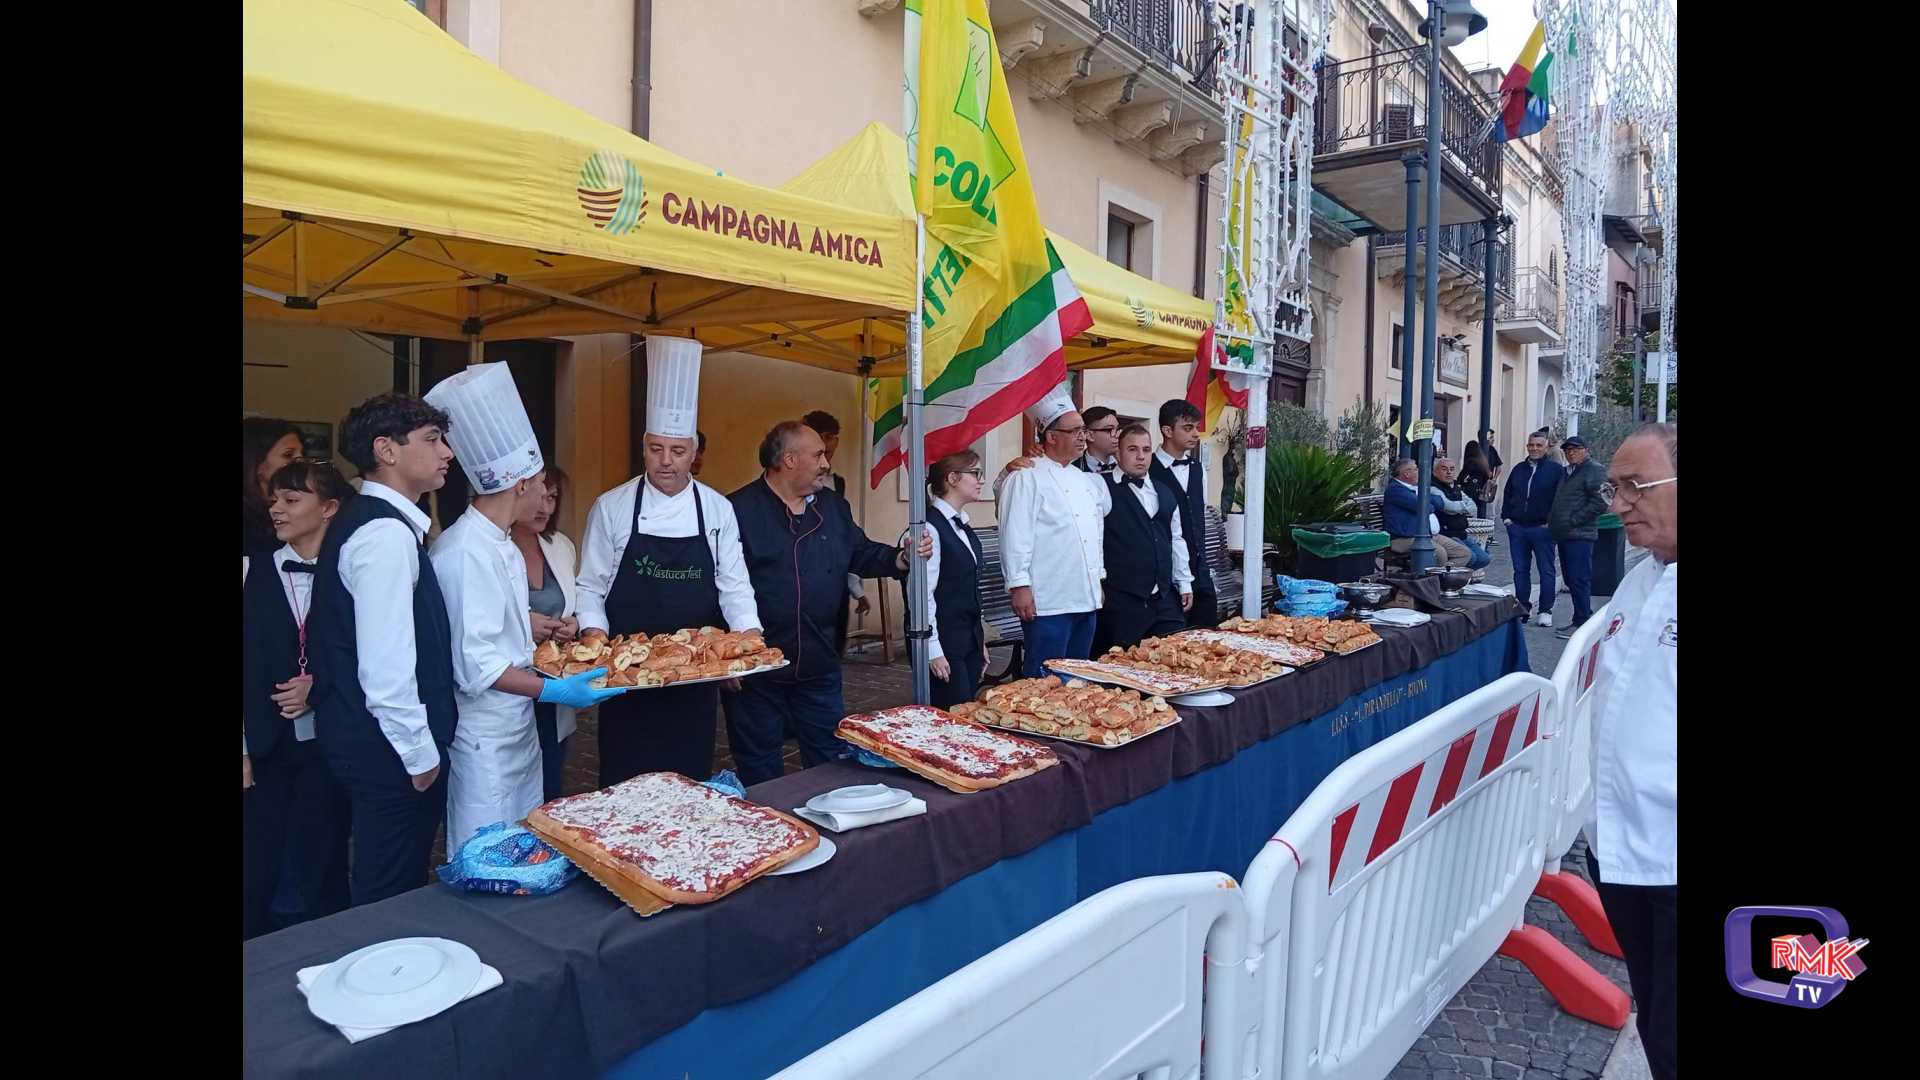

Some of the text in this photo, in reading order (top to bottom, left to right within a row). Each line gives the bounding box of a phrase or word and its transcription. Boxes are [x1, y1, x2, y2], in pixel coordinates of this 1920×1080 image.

[934, 145, 998, 226] COL
[661, 192, 883, 268] CAMPAGNA AMICA
